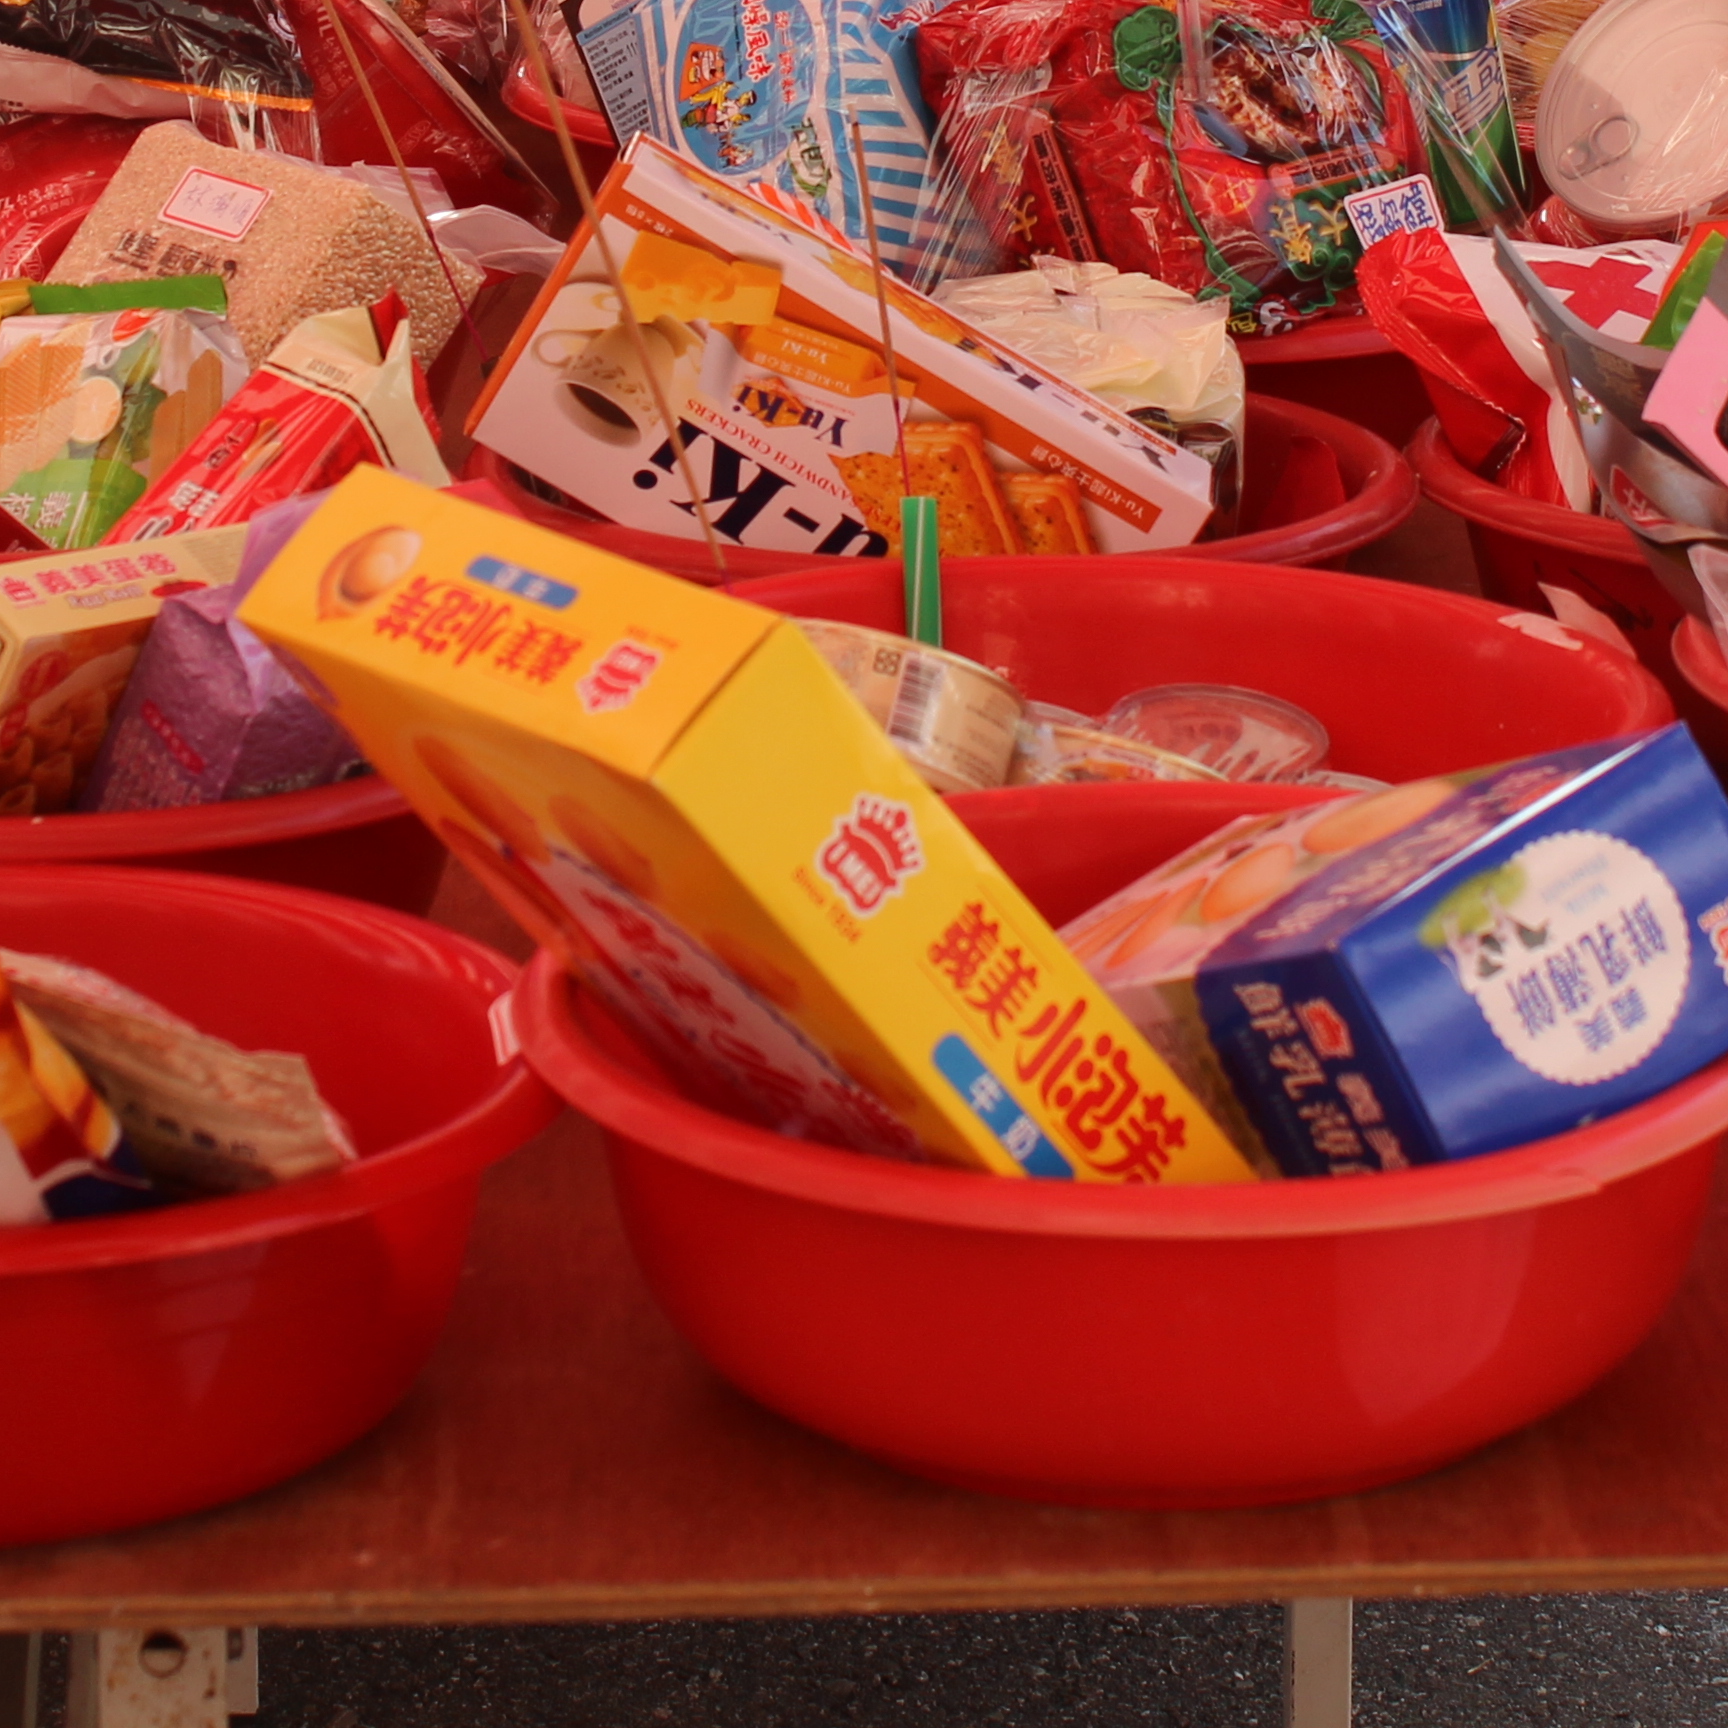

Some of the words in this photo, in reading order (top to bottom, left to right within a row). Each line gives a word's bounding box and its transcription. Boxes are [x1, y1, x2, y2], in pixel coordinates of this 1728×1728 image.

[685, 397, 774, 459] CRACKERS
[731, 381, 850, 450] Yu-Ki
[1509, 894, 1669, 1037] 鮮乳薄餅
[927, 899, 1189, 1184] 義美小泡芙
